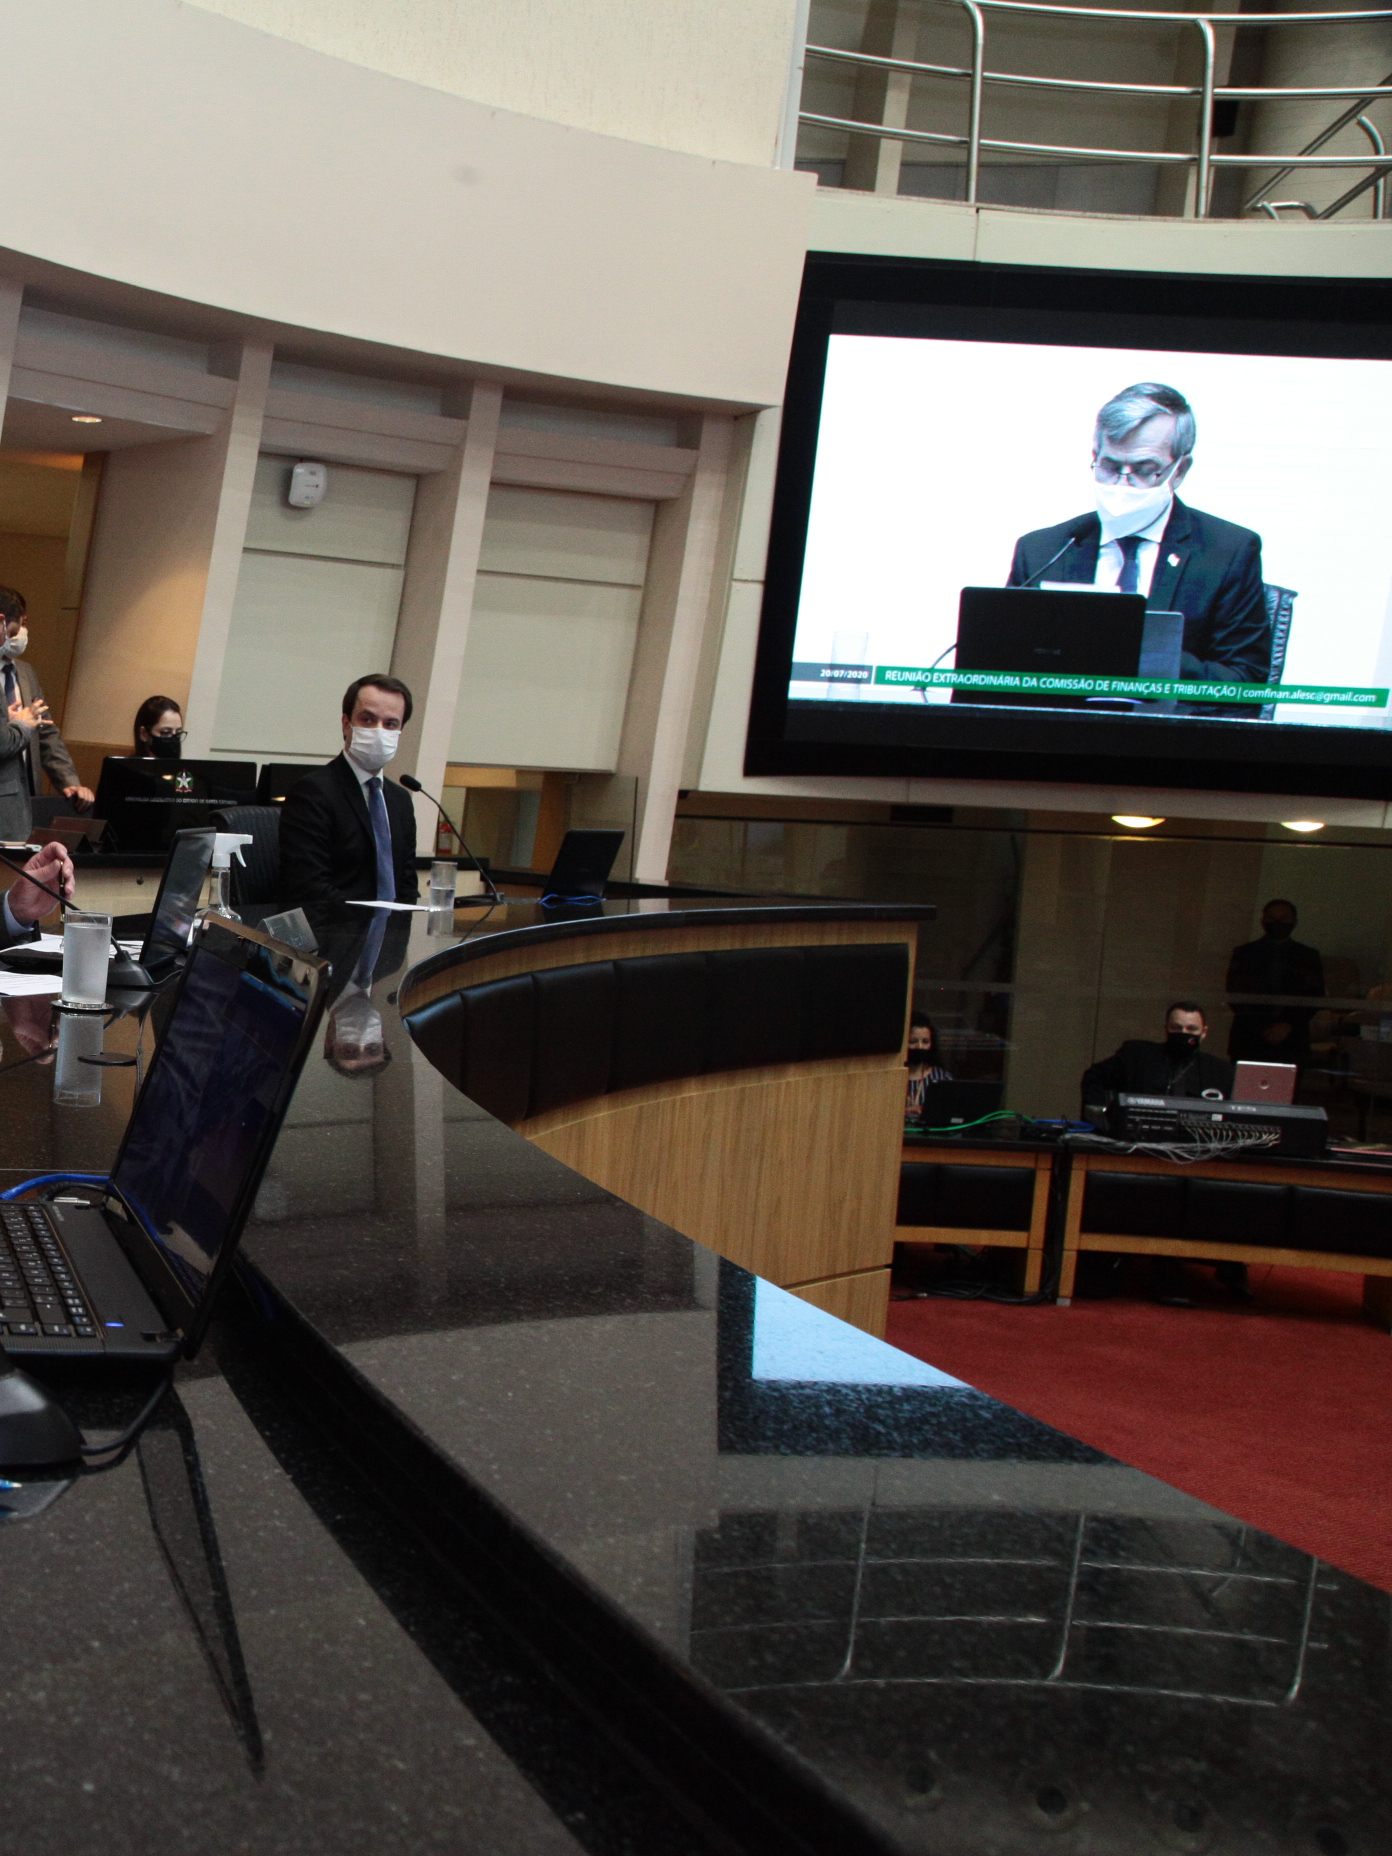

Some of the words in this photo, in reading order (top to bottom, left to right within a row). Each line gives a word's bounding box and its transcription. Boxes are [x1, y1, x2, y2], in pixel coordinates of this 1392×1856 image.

[820, 668, 868, 679] 20/07/2020
[885, 669, 931, 683] REUNIÃO
[932, 672, 1020, 687] EXTRAORDINÁRIA
[1022, 677, 1038, 688] DA
[1039, 676, 1094, 690] COMISSÃO
[1095, 680, 1109, 691] DE
[1111, 681, 1162, 696] FINANÇAS
[1164, 682, 1171, 694] E
[1173, 683, 1236, 699] TRIBUTAÇÃO
[1243, 688, 1376, 704] comfinan.alesc@gmail.com
